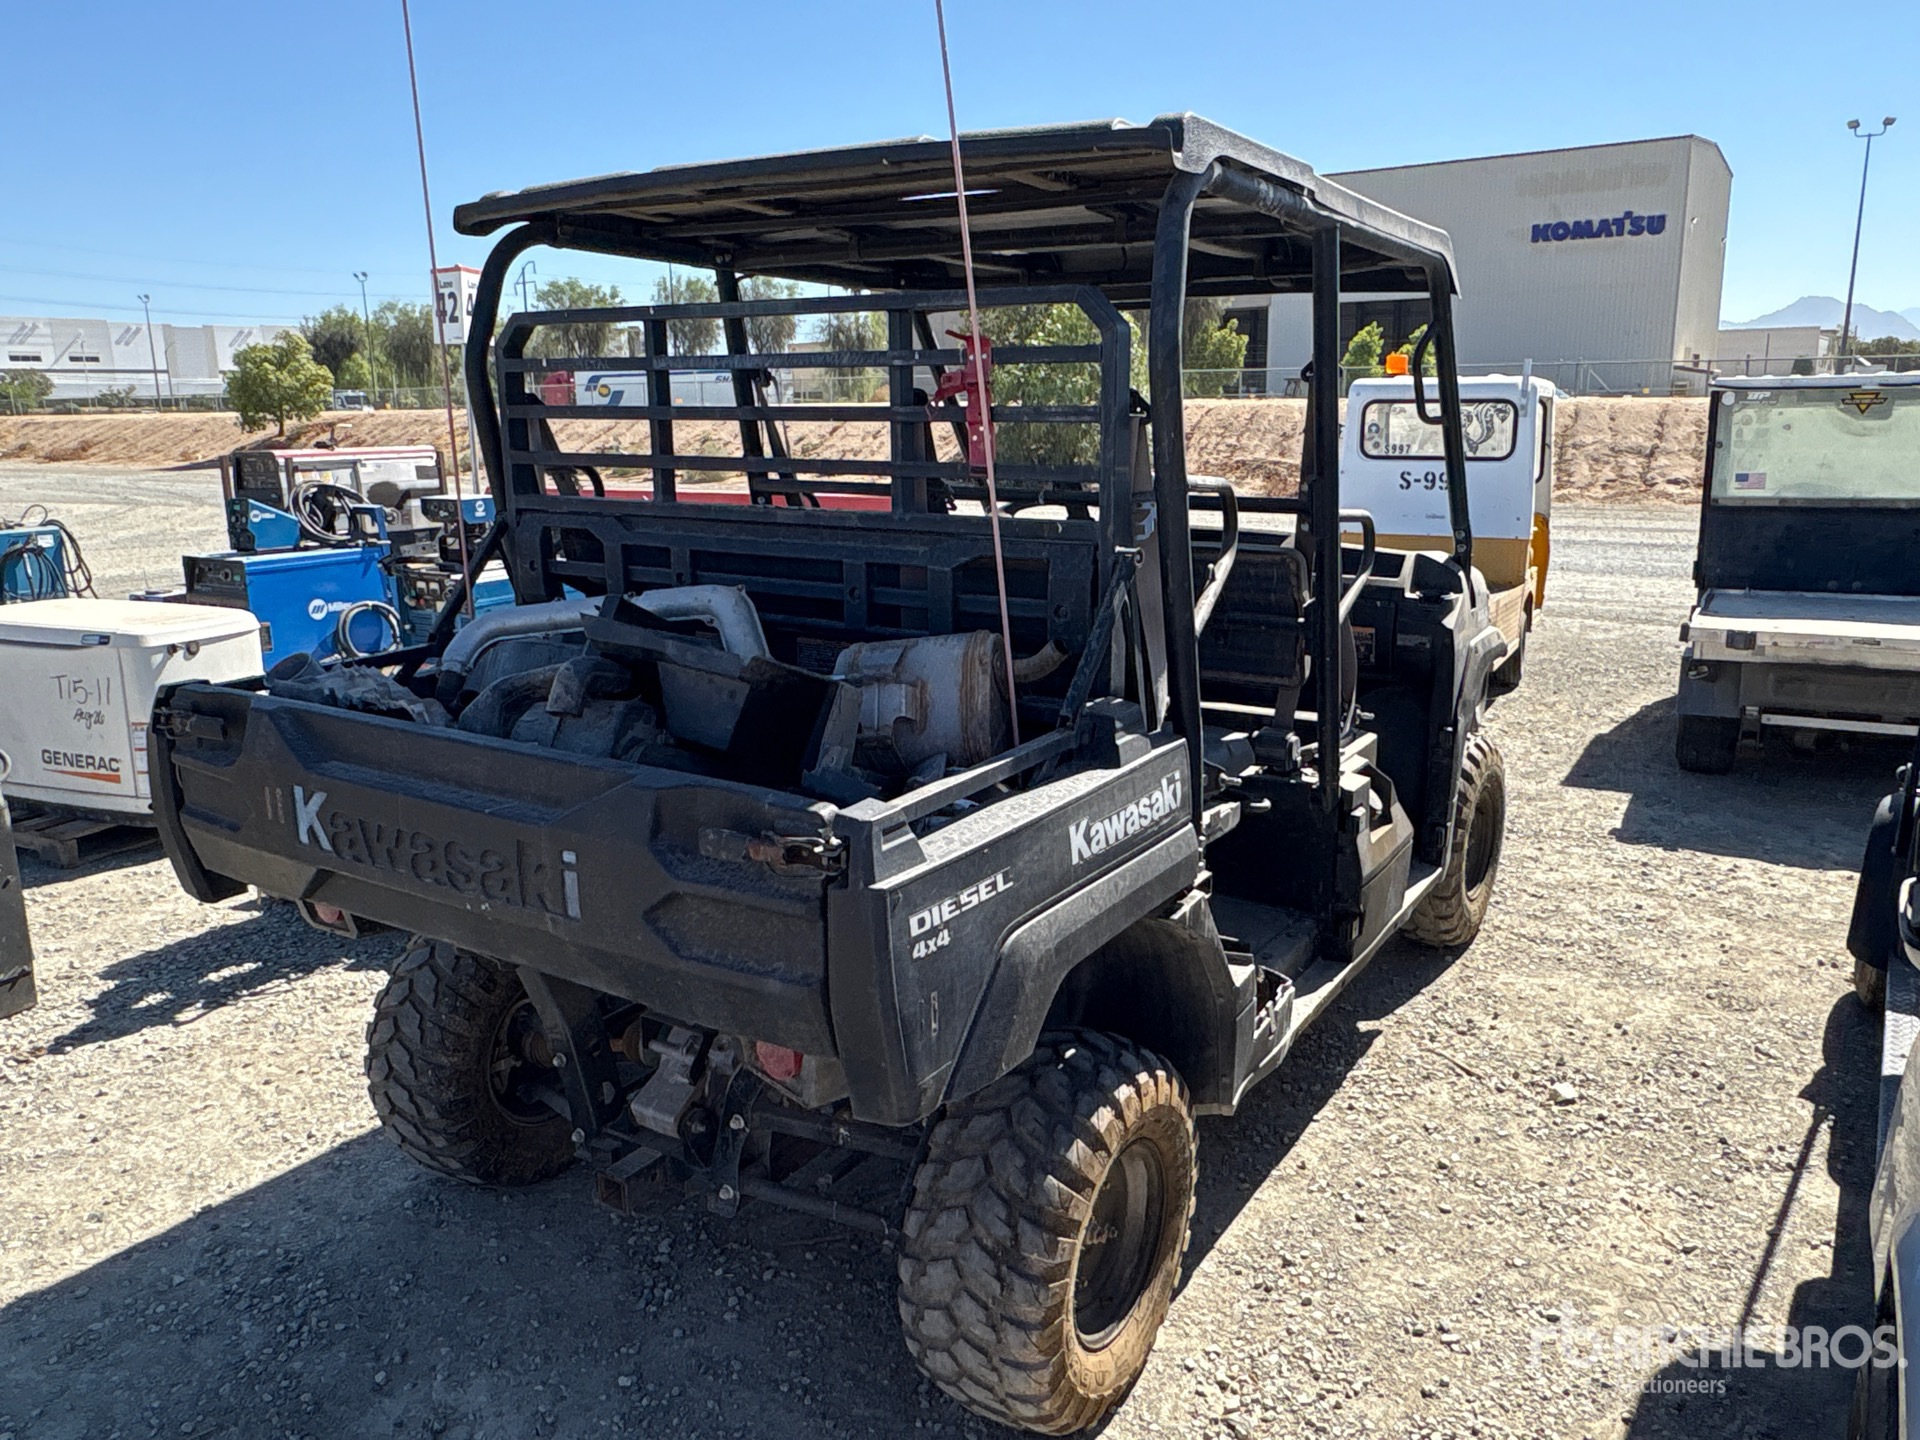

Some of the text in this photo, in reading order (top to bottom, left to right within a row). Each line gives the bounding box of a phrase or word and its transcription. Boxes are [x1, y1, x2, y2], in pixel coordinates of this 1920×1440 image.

[1531, 211, 1666, 242] KOMATSU
[436, 292, 459, 323] 42
[1384, 444, 1411, 454] S997
[1399, 471, 1448, 490] S-99
[41, 749, 121, 772] GENERAC
[1068, 770, 1182, 865] Kawasaki
[292, 784, 582, 920] Kawasaki
[908, 871, 1014, 938] DIESEL
[911, 928, 951, 960] 4x4
